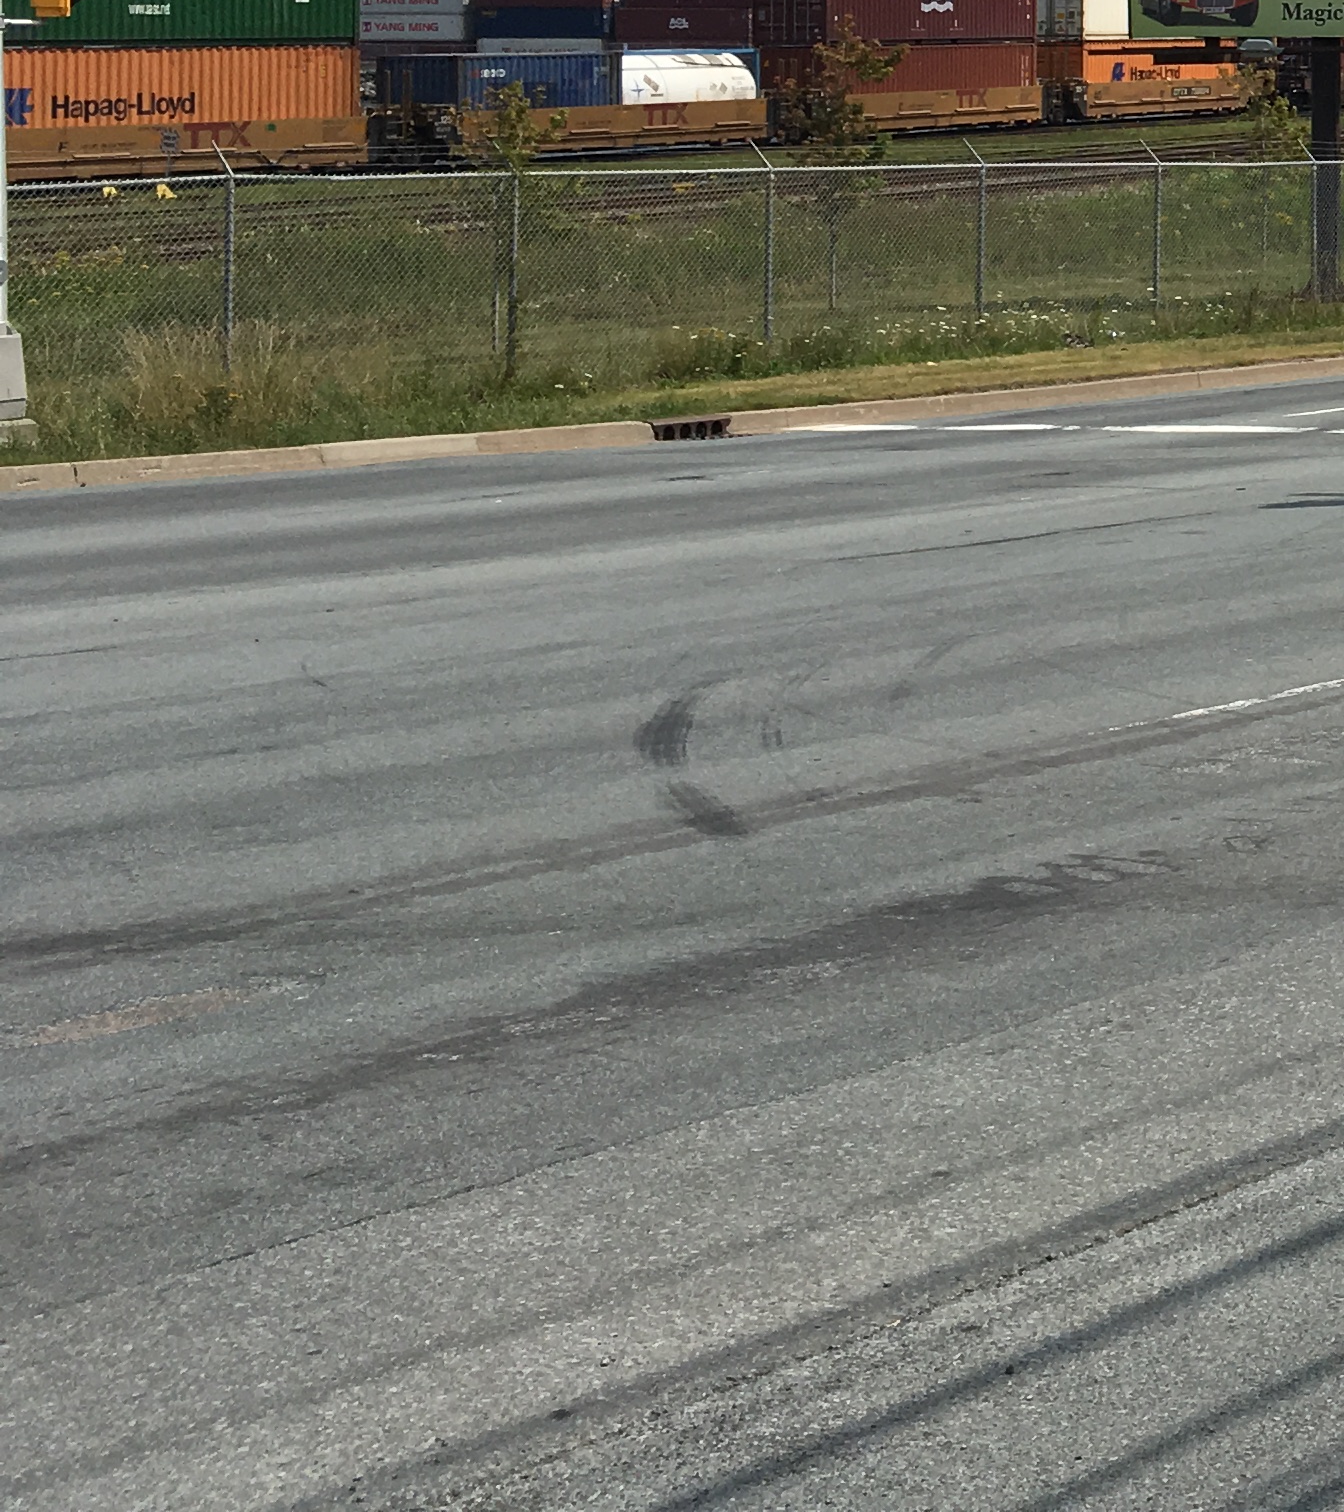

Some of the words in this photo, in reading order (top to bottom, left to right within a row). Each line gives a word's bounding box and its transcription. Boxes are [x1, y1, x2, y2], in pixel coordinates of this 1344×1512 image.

[374, 22, 405, 32] YANG
[408, 22, 439, 32] MING
[51, 92, 196, 123] Hapag-Lloyd
[183, 121, 252, 149] TTX
